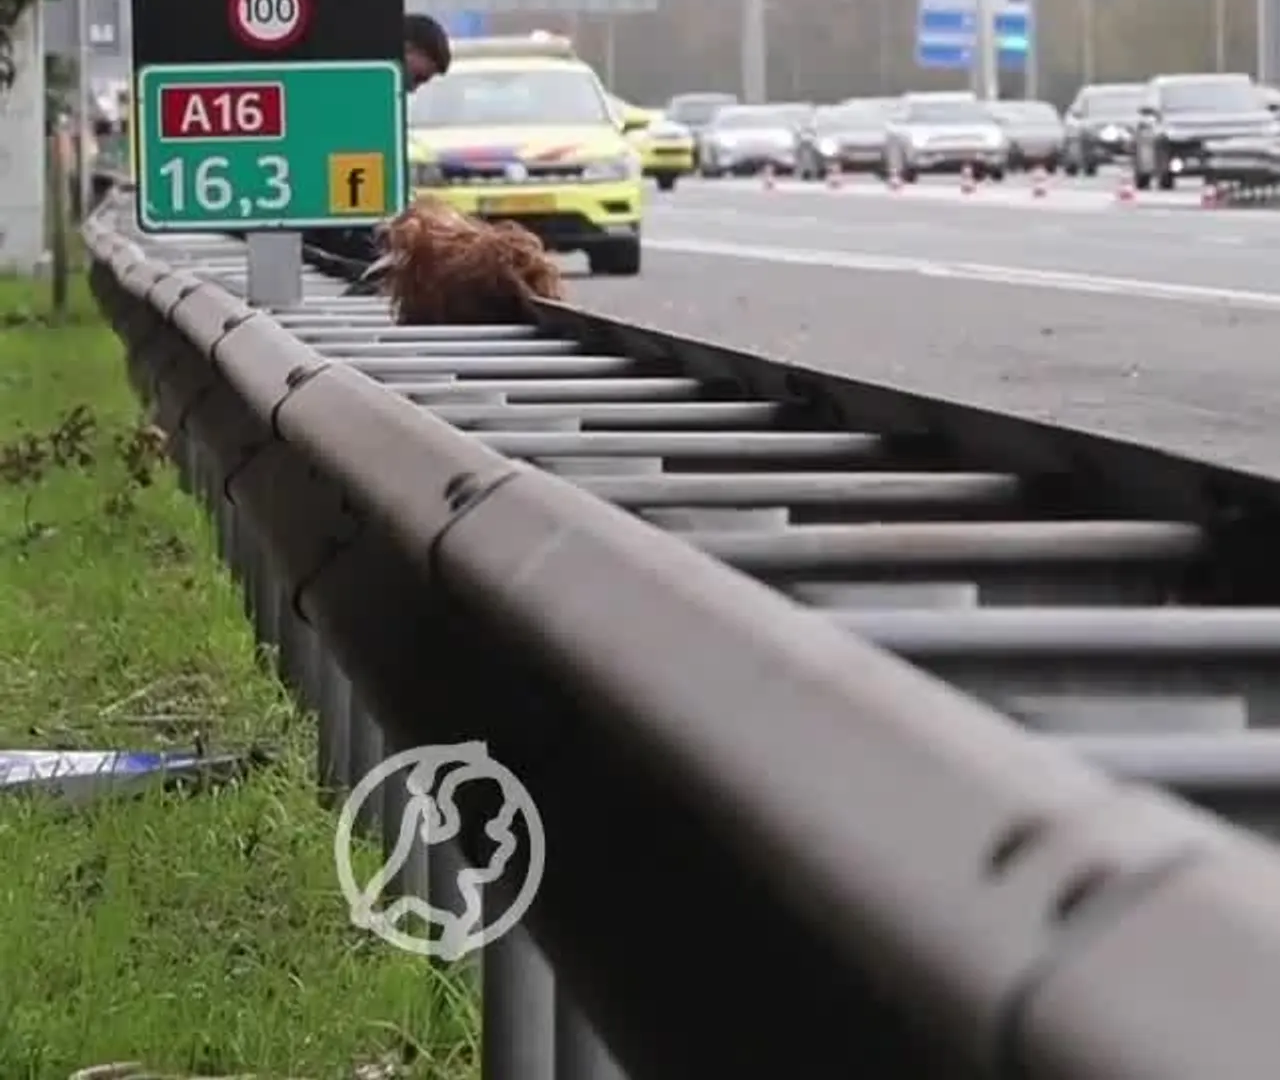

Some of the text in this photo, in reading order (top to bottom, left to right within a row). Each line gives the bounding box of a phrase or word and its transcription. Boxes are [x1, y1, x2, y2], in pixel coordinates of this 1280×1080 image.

[180, 91, 264, 132] A16
[160, 155, 292, 217] 16,3
[346, 168, 365, 207] f
